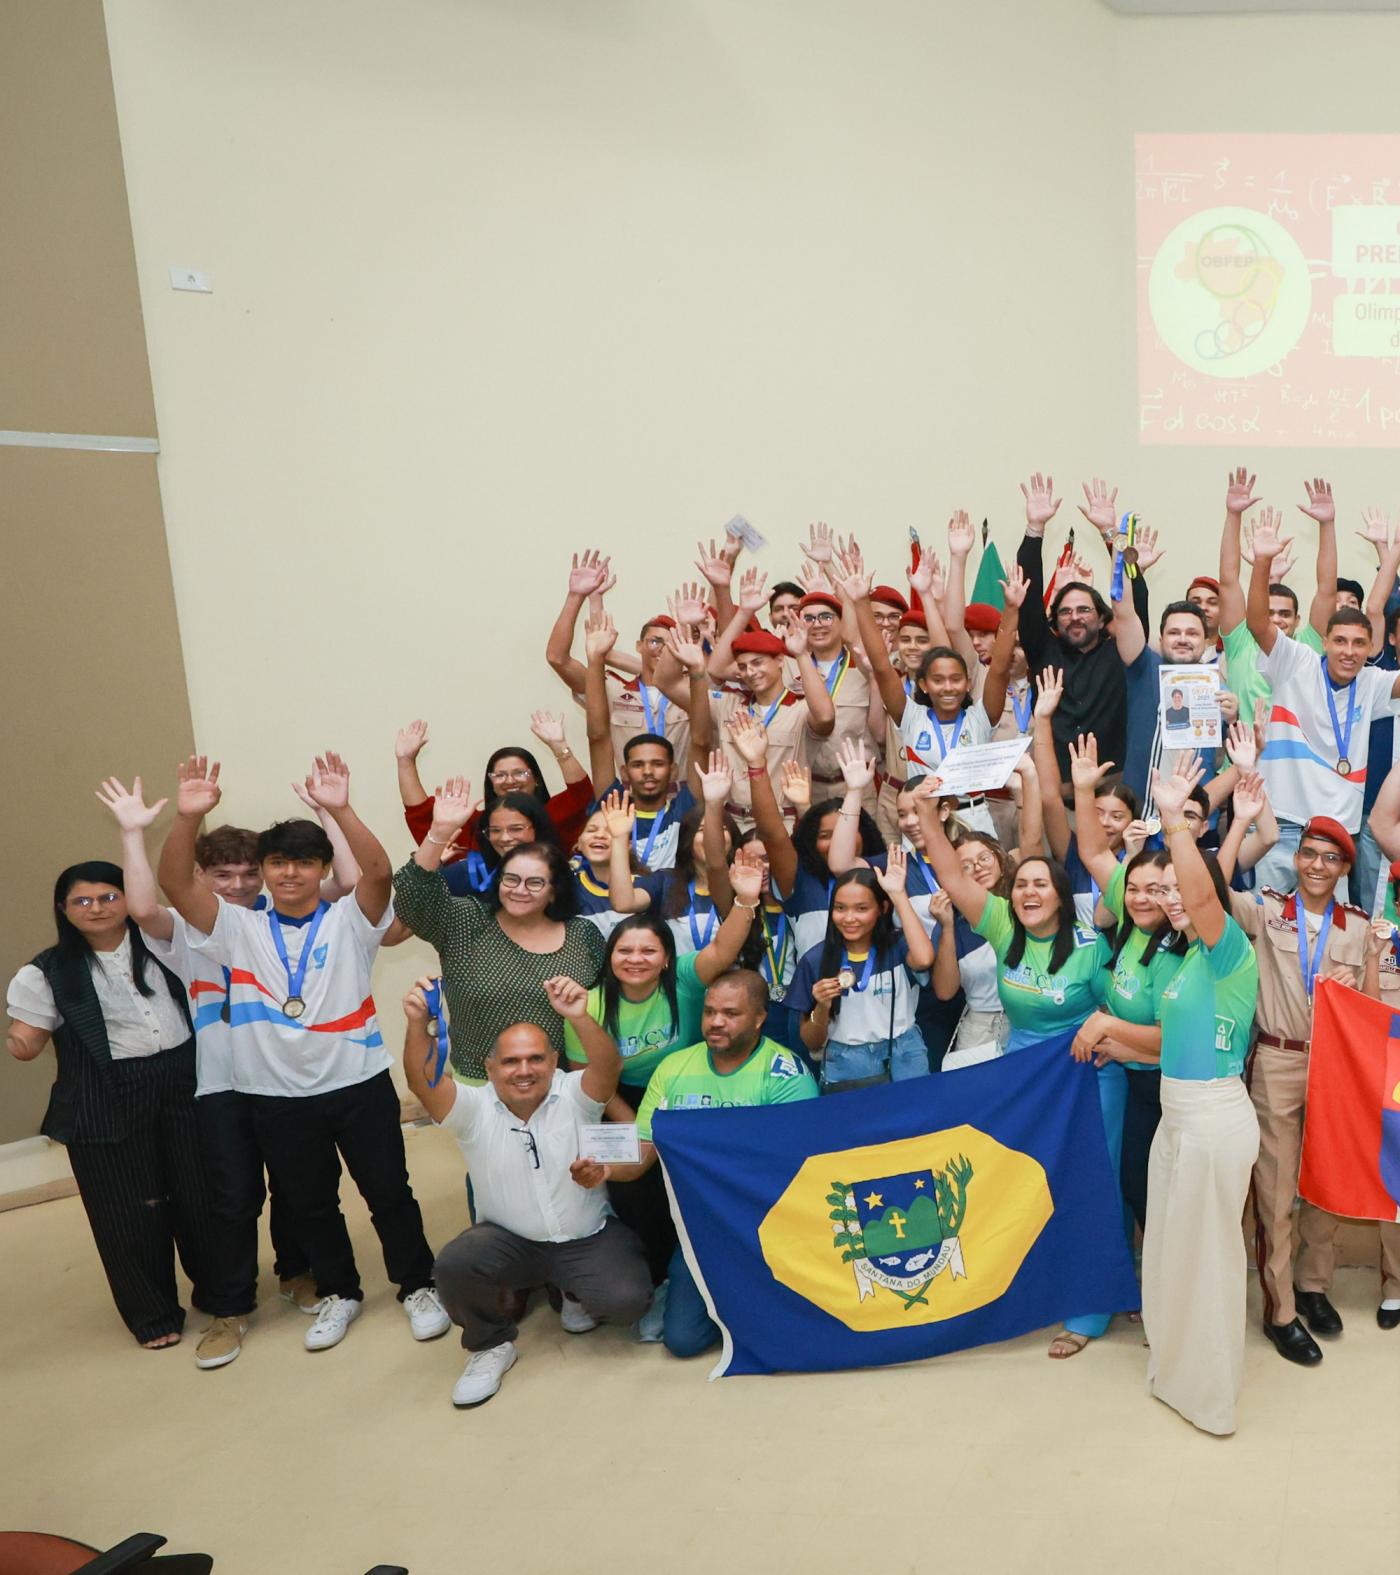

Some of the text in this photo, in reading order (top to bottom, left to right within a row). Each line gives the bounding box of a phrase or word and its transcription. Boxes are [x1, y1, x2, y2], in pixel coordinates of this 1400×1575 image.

[1200, 255, 1254, 268] OBFEP
[860, 1263, 903, 1288] SANTANA
[906, 1278, 921, 1288] DO
